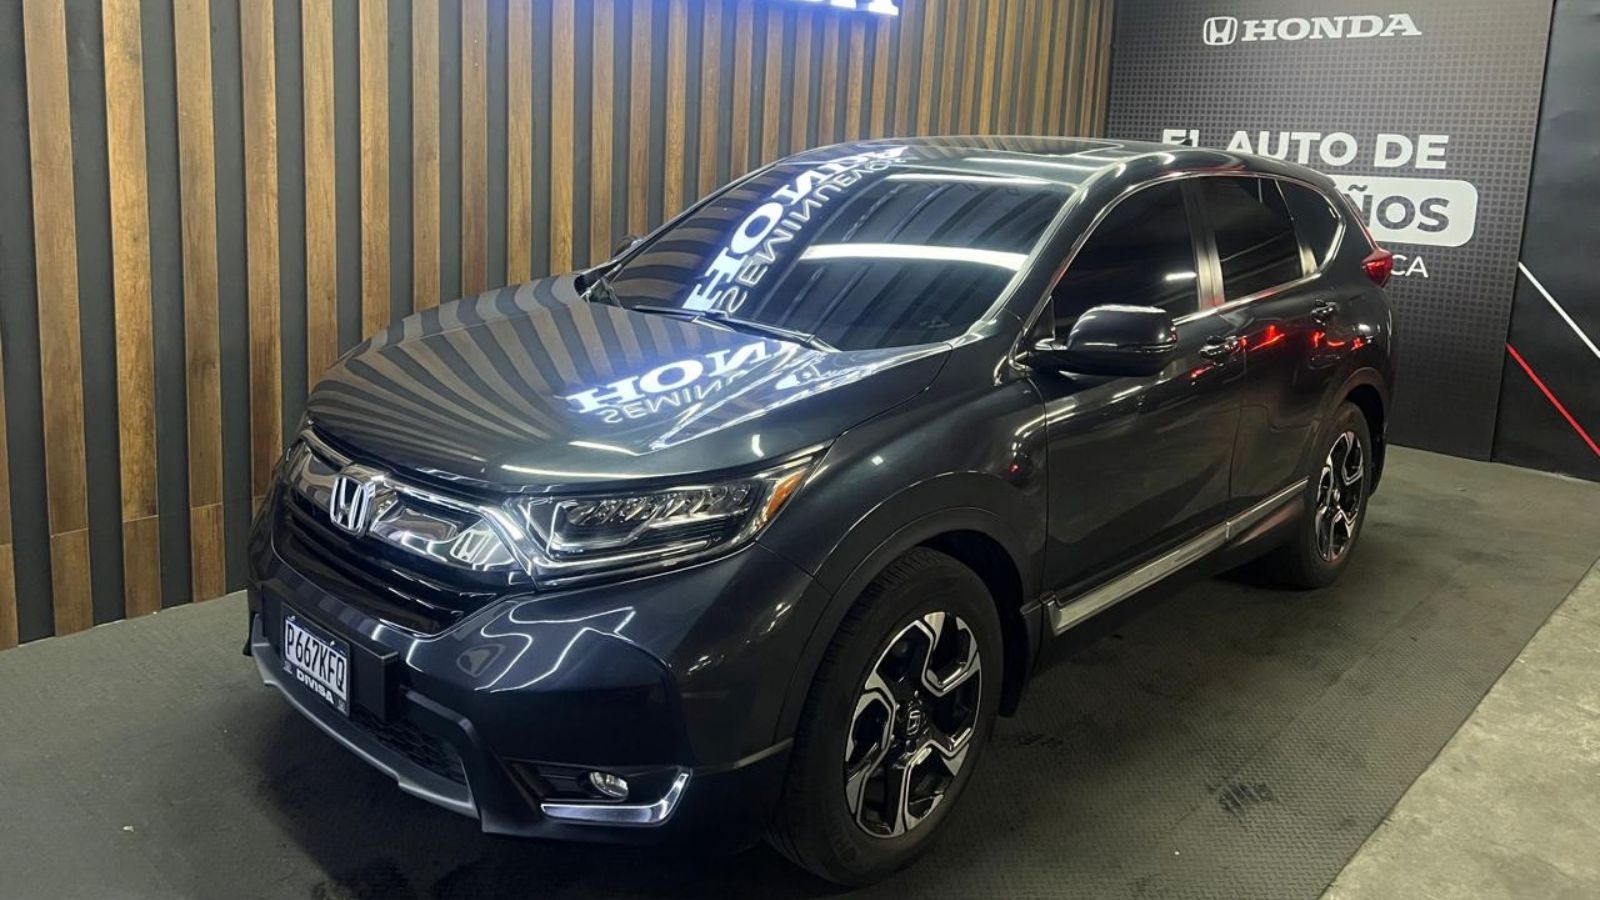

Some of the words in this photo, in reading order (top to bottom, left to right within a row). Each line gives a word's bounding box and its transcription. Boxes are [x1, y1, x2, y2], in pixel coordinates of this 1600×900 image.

[1241, 13, 1422, 42] HONDA
[1226, 130, 1358, 167] AUTO
[1374, 133, 1449, 169] DE
[287, 623, 346, 693] P667KFQ
[296, 668, 335, 705] DIVISA
